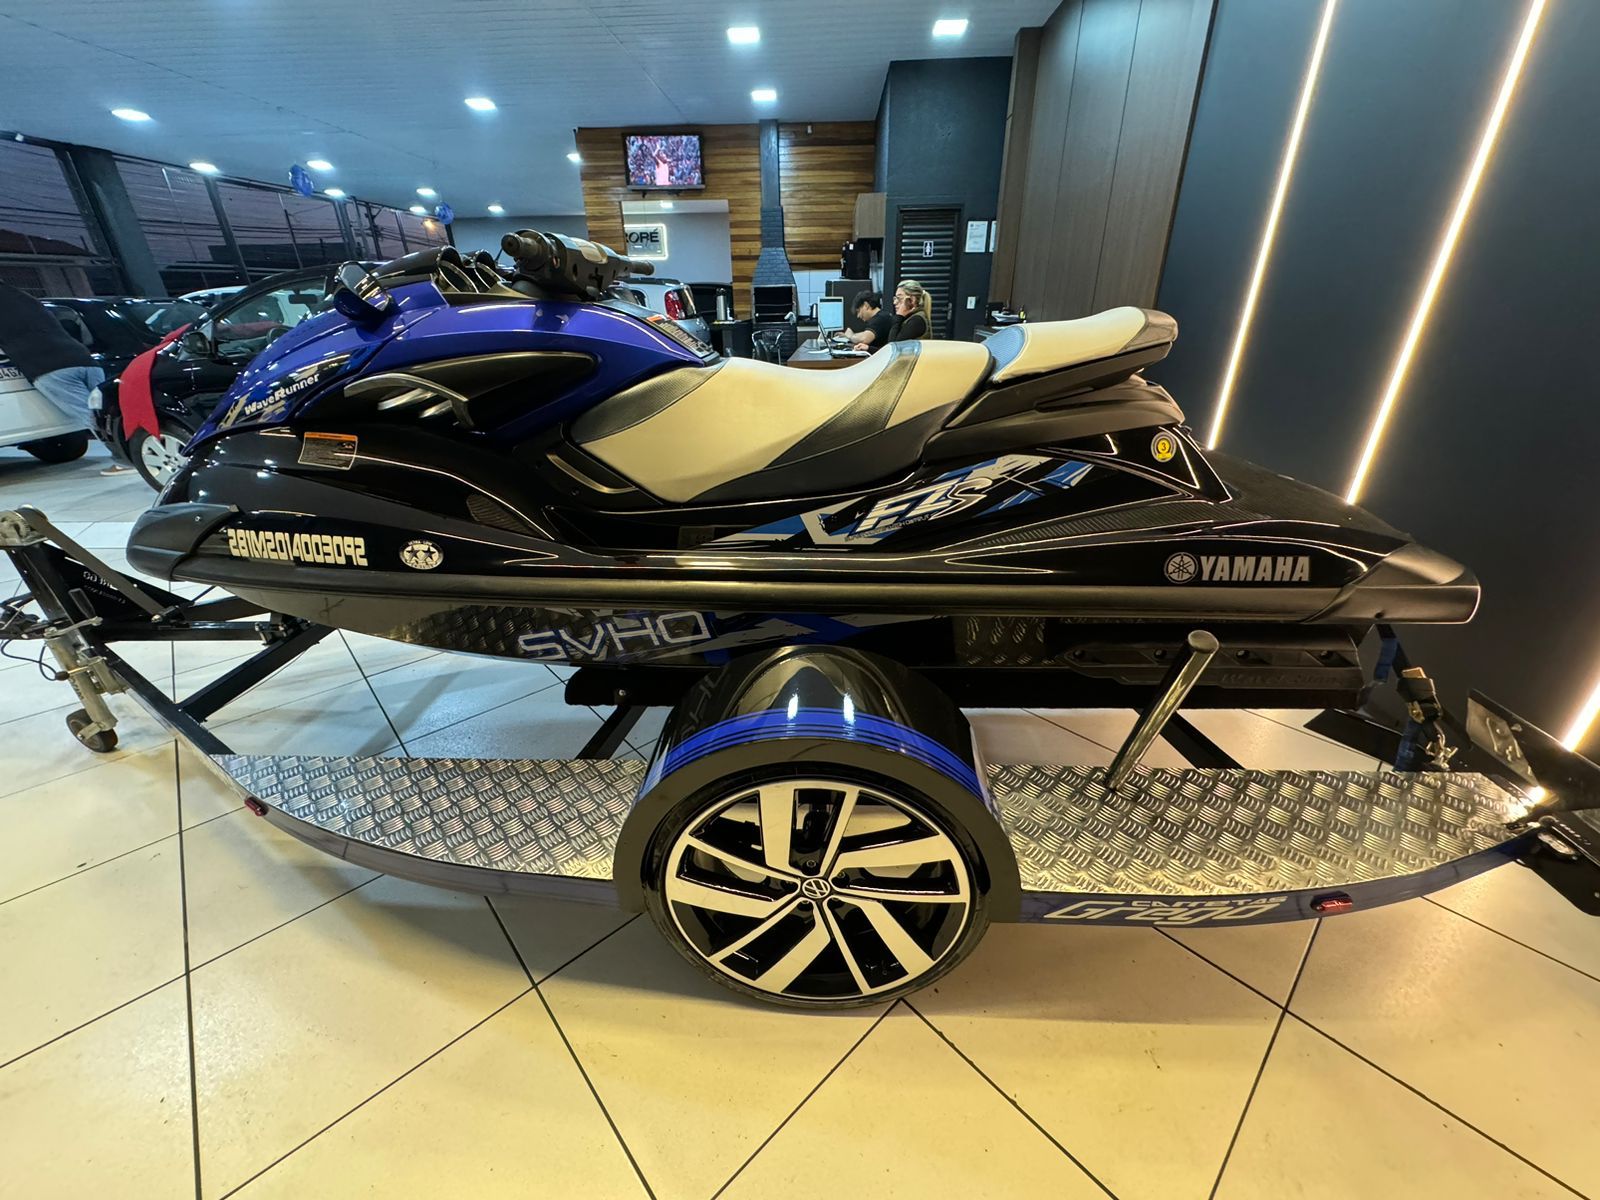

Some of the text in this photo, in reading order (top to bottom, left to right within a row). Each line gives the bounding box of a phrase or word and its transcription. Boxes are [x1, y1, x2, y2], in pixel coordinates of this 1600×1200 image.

[244, 373, 320, 415] WaveRunner
[1200, 555, 1310, 582] YAMAHA
[517, 610, 712, 662] SVHO
